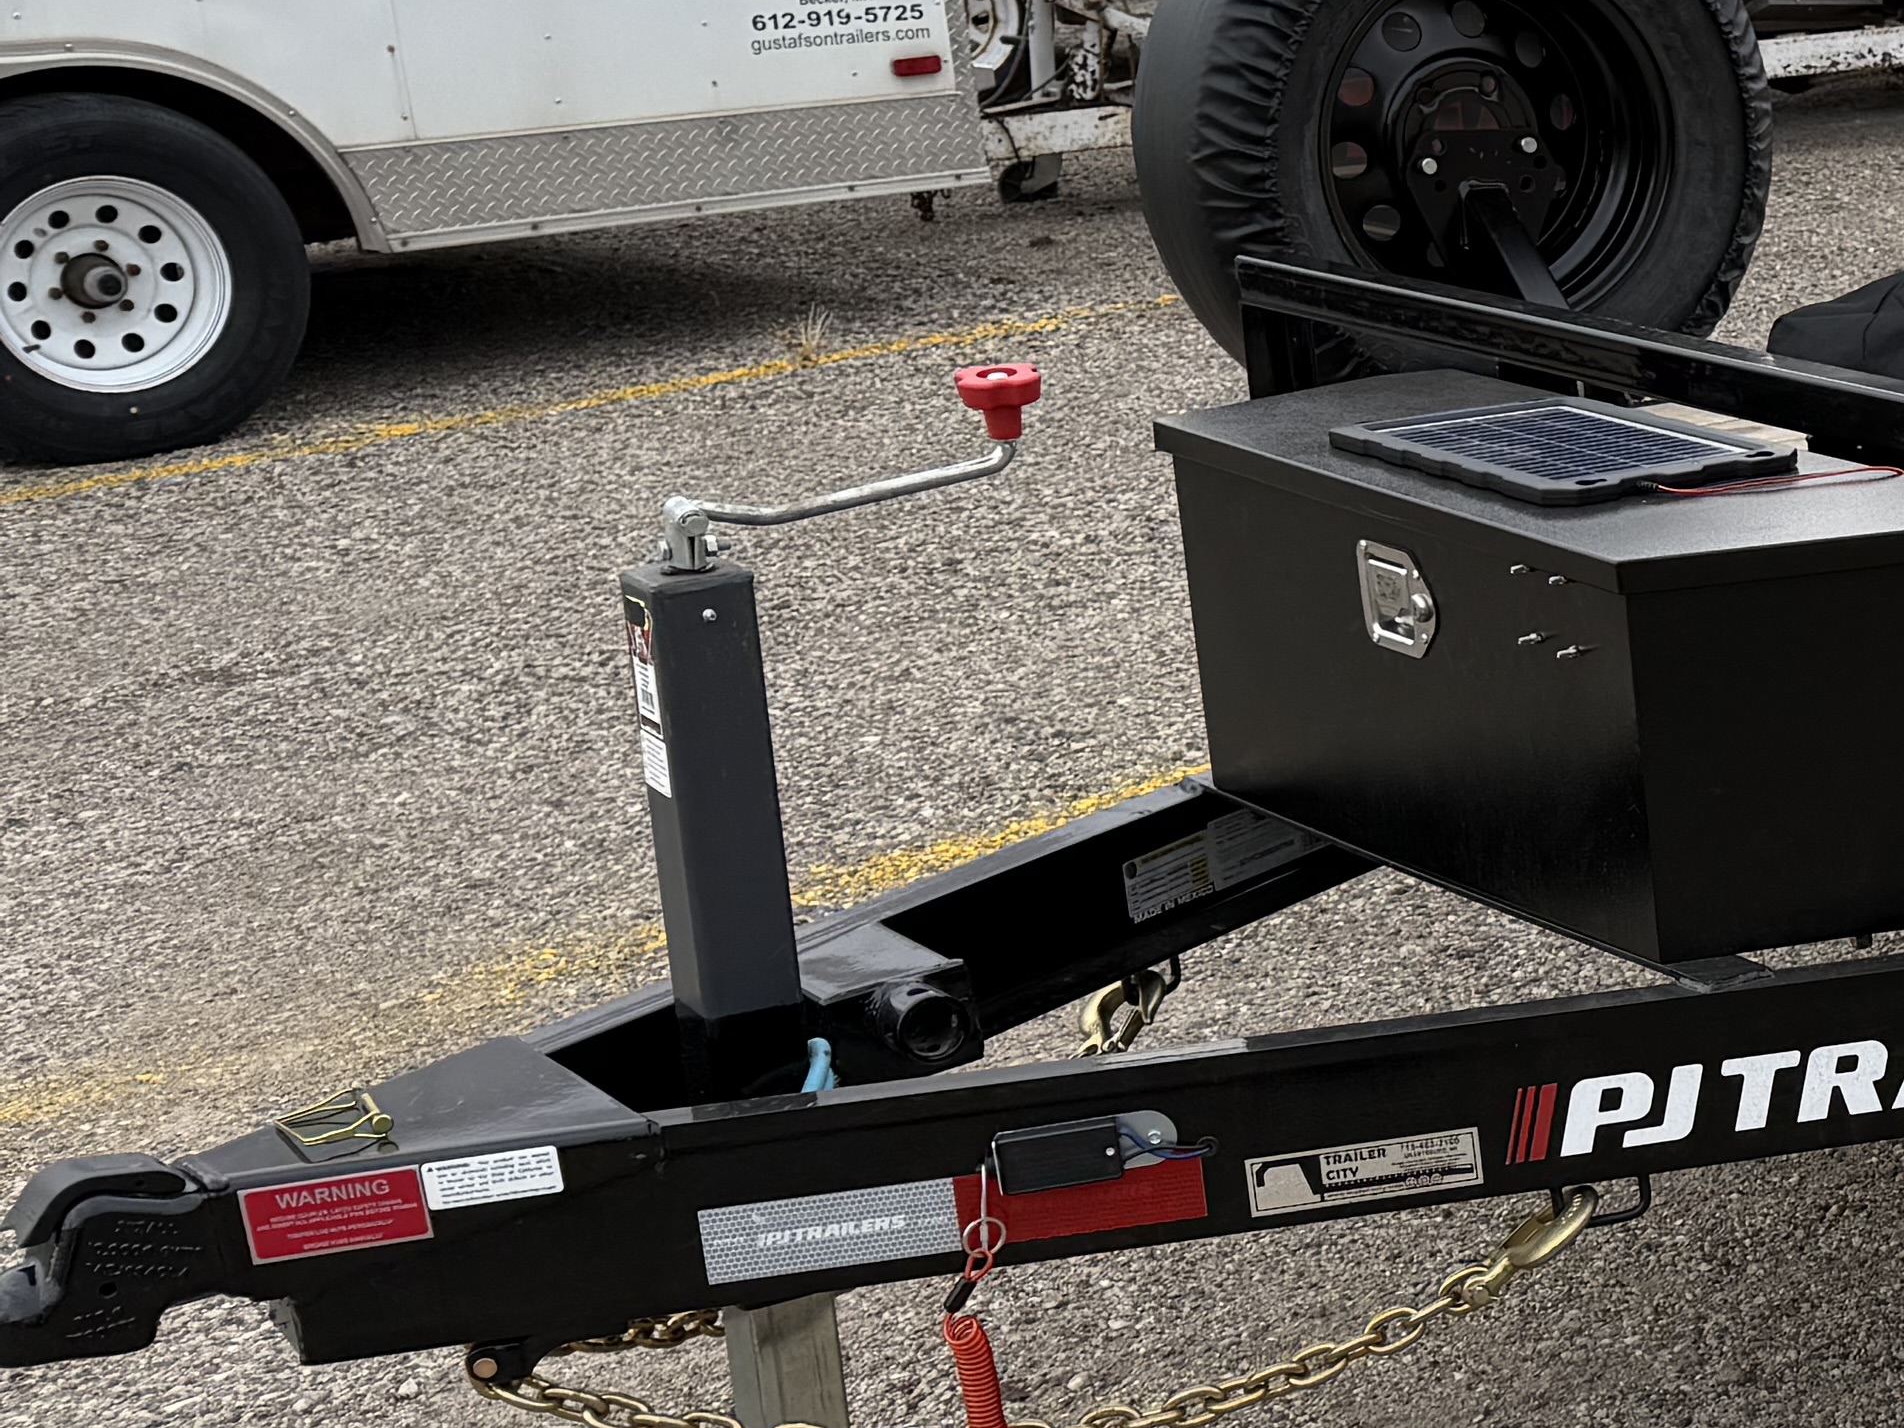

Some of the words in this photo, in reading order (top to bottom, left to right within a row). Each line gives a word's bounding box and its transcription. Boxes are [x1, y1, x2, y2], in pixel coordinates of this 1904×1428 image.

[751, 3, 924, 31] 612-919-5725
[750, 27, 931, 55] gustafsontrailers.com
[1323, 1147, 1387, 1166] TRAILER
[1325, 1166, 1358, 1181] CITY
[275, 1179, 390, 1210] WARNING
